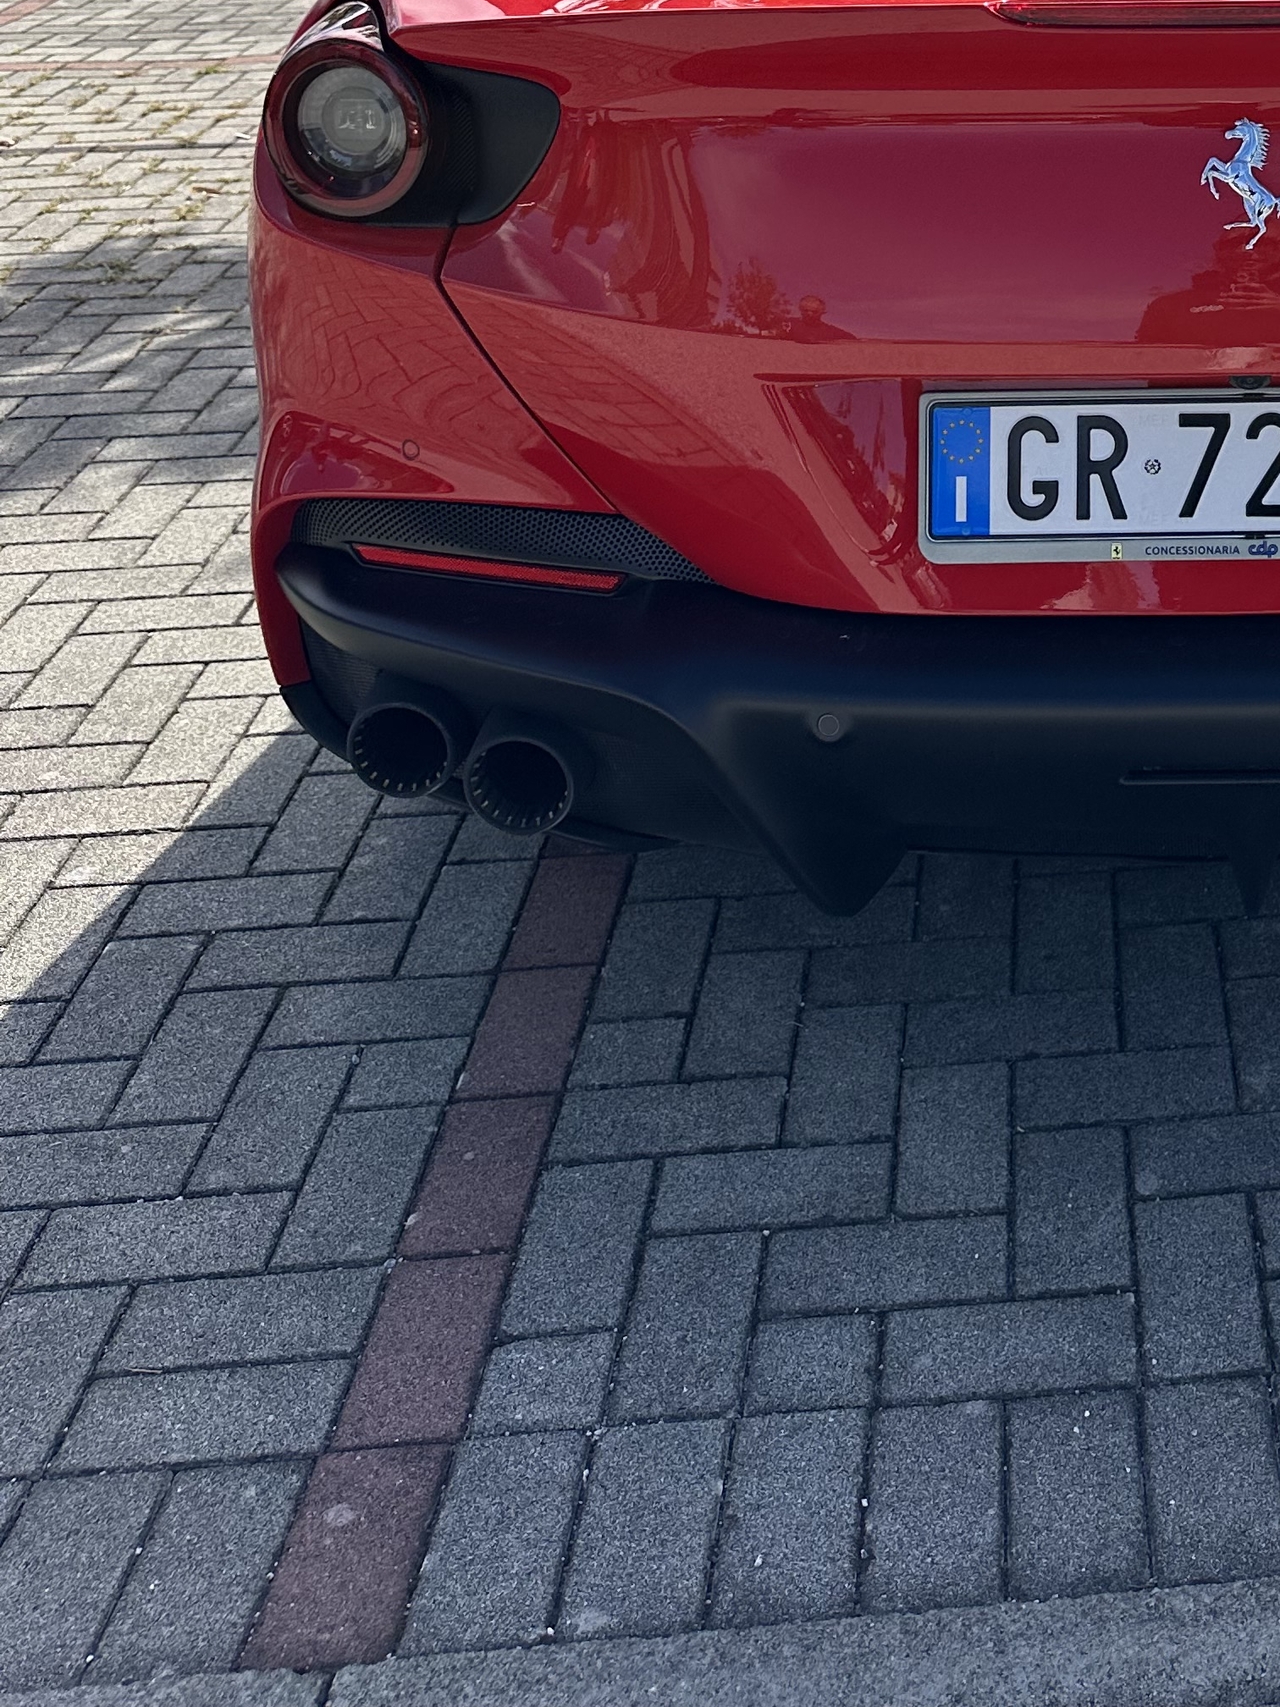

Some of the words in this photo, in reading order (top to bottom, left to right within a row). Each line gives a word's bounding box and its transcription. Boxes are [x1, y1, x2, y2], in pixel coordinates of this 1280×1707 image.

[1006, 414, 1129, 522] GR
[955, 475, 968, 523] I
[1144, 544, 1241, 556] CONCESSIONARIA
[1248, 540, 1279, 559] cdp
